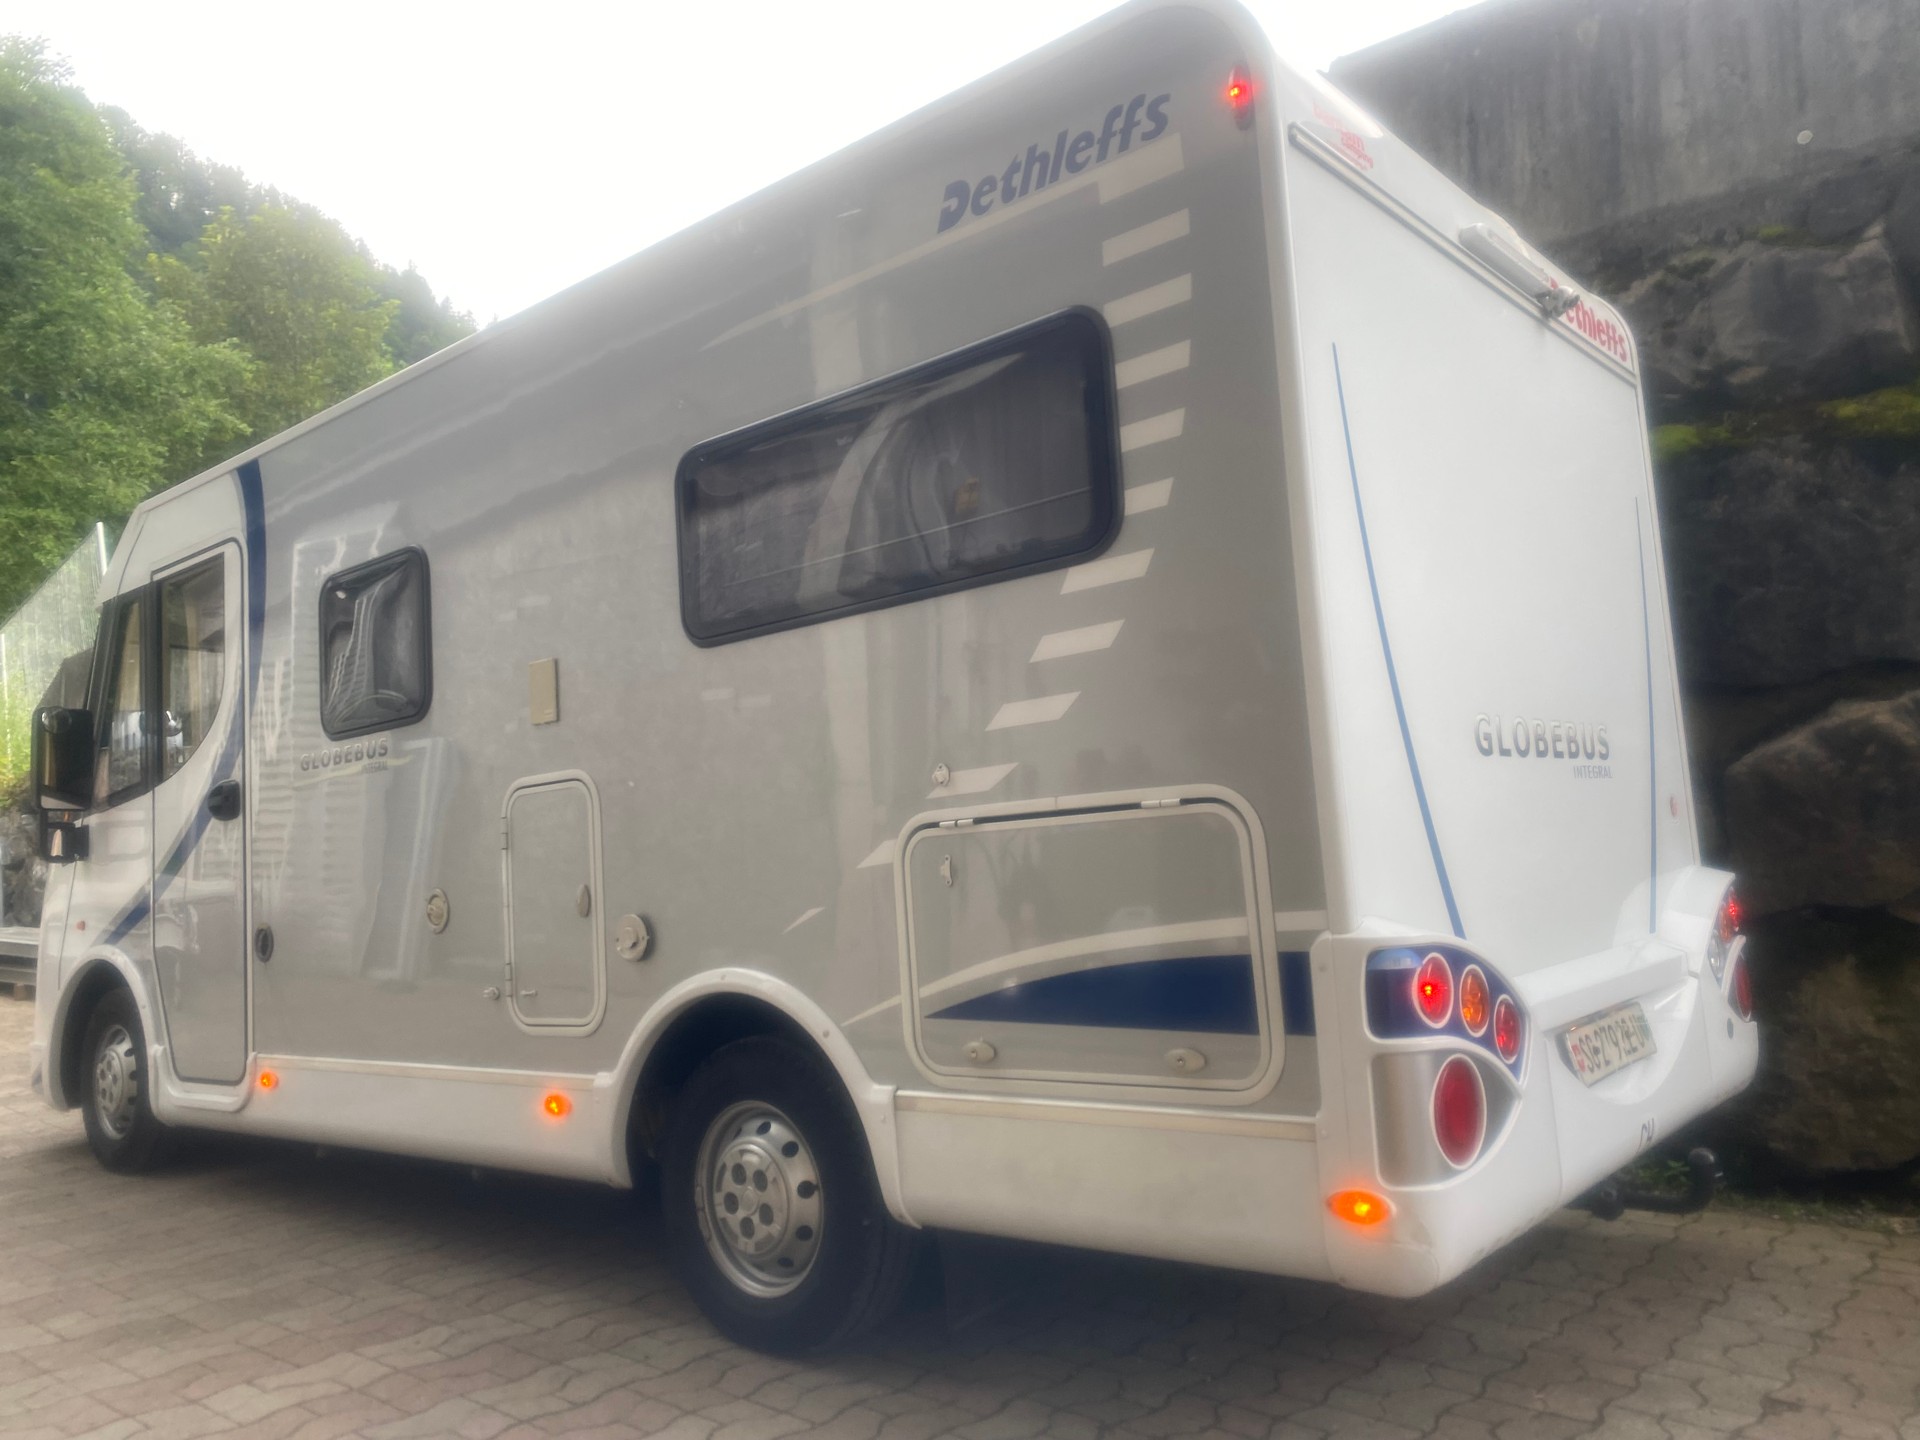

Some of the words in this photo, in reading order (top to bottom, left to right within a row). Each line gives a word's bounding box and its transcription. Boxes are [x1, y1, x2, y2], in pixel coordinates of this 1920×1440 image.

[937, 93, 1171, 235] Dethleffs
[1550, 276, 1628, 362] ethleffs
[300, 738, 389, 772] GLOBEBUS
[1474, 713, 1610, 761] GLOBEBUS
[1572, 764, 1613, 780] INTEGRAL
